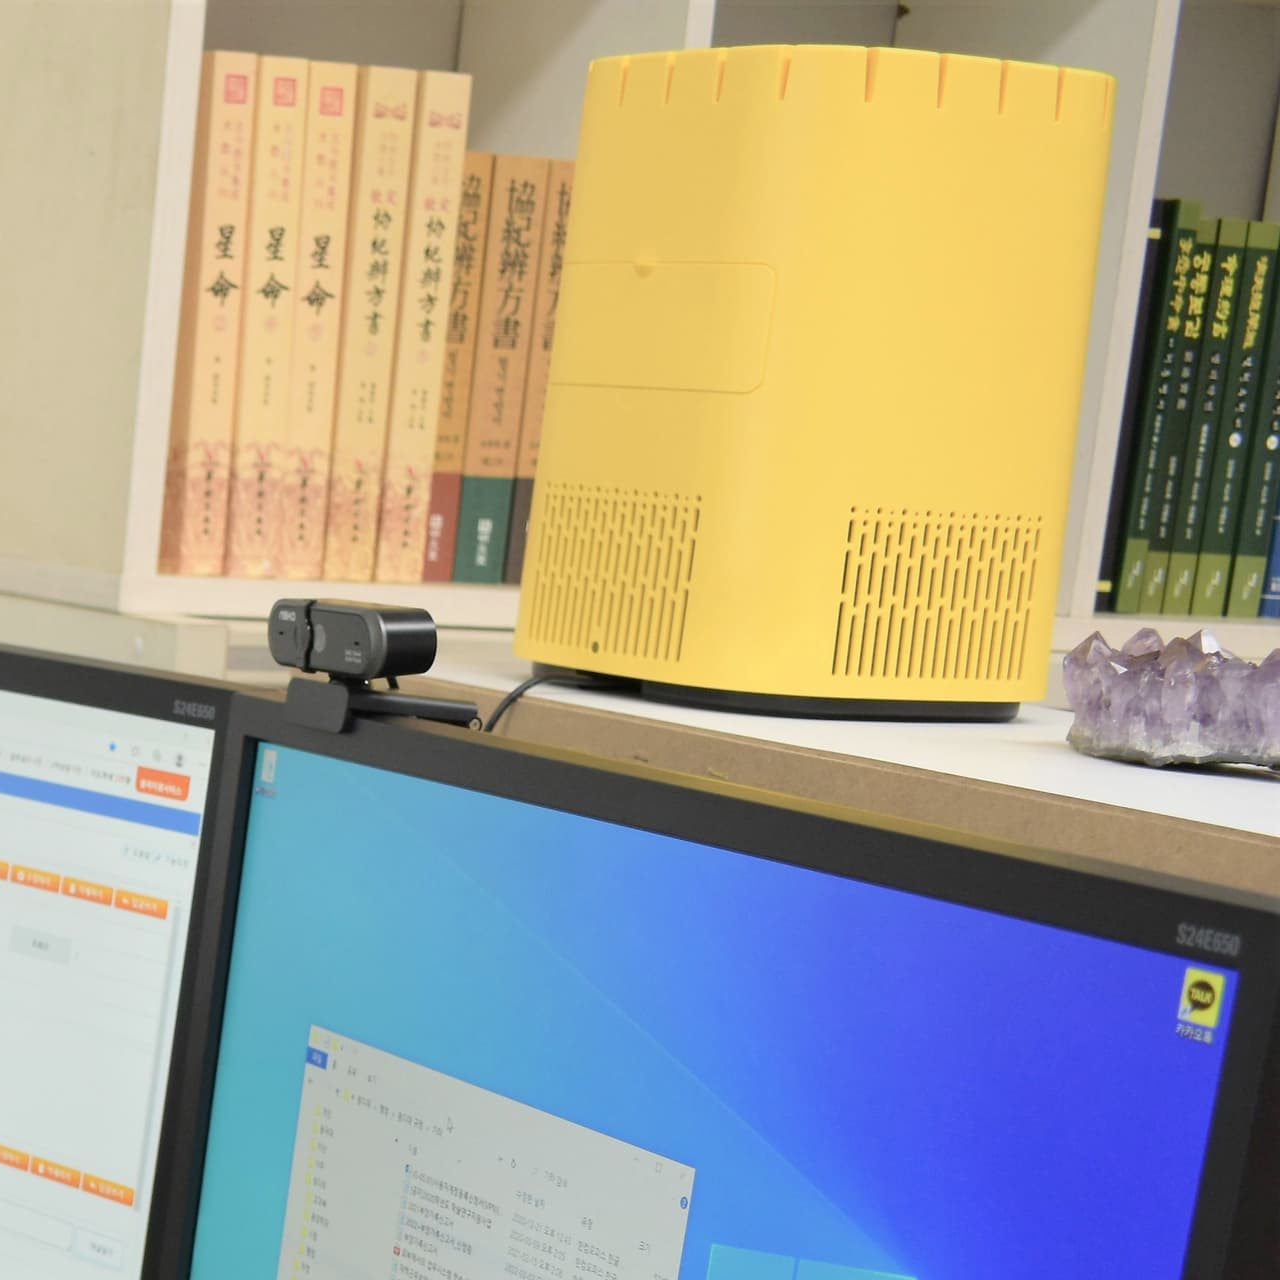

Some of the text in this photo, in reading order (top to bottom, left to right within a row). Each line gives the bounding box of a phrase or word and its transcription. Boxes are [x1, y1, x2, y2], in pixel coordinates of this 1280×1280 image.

[1176, 923, 1241, 957] S24E650
[1190, 988, 1214, 1003] TALK
[1176, 1023, 1214, 1045] 카카오톡
